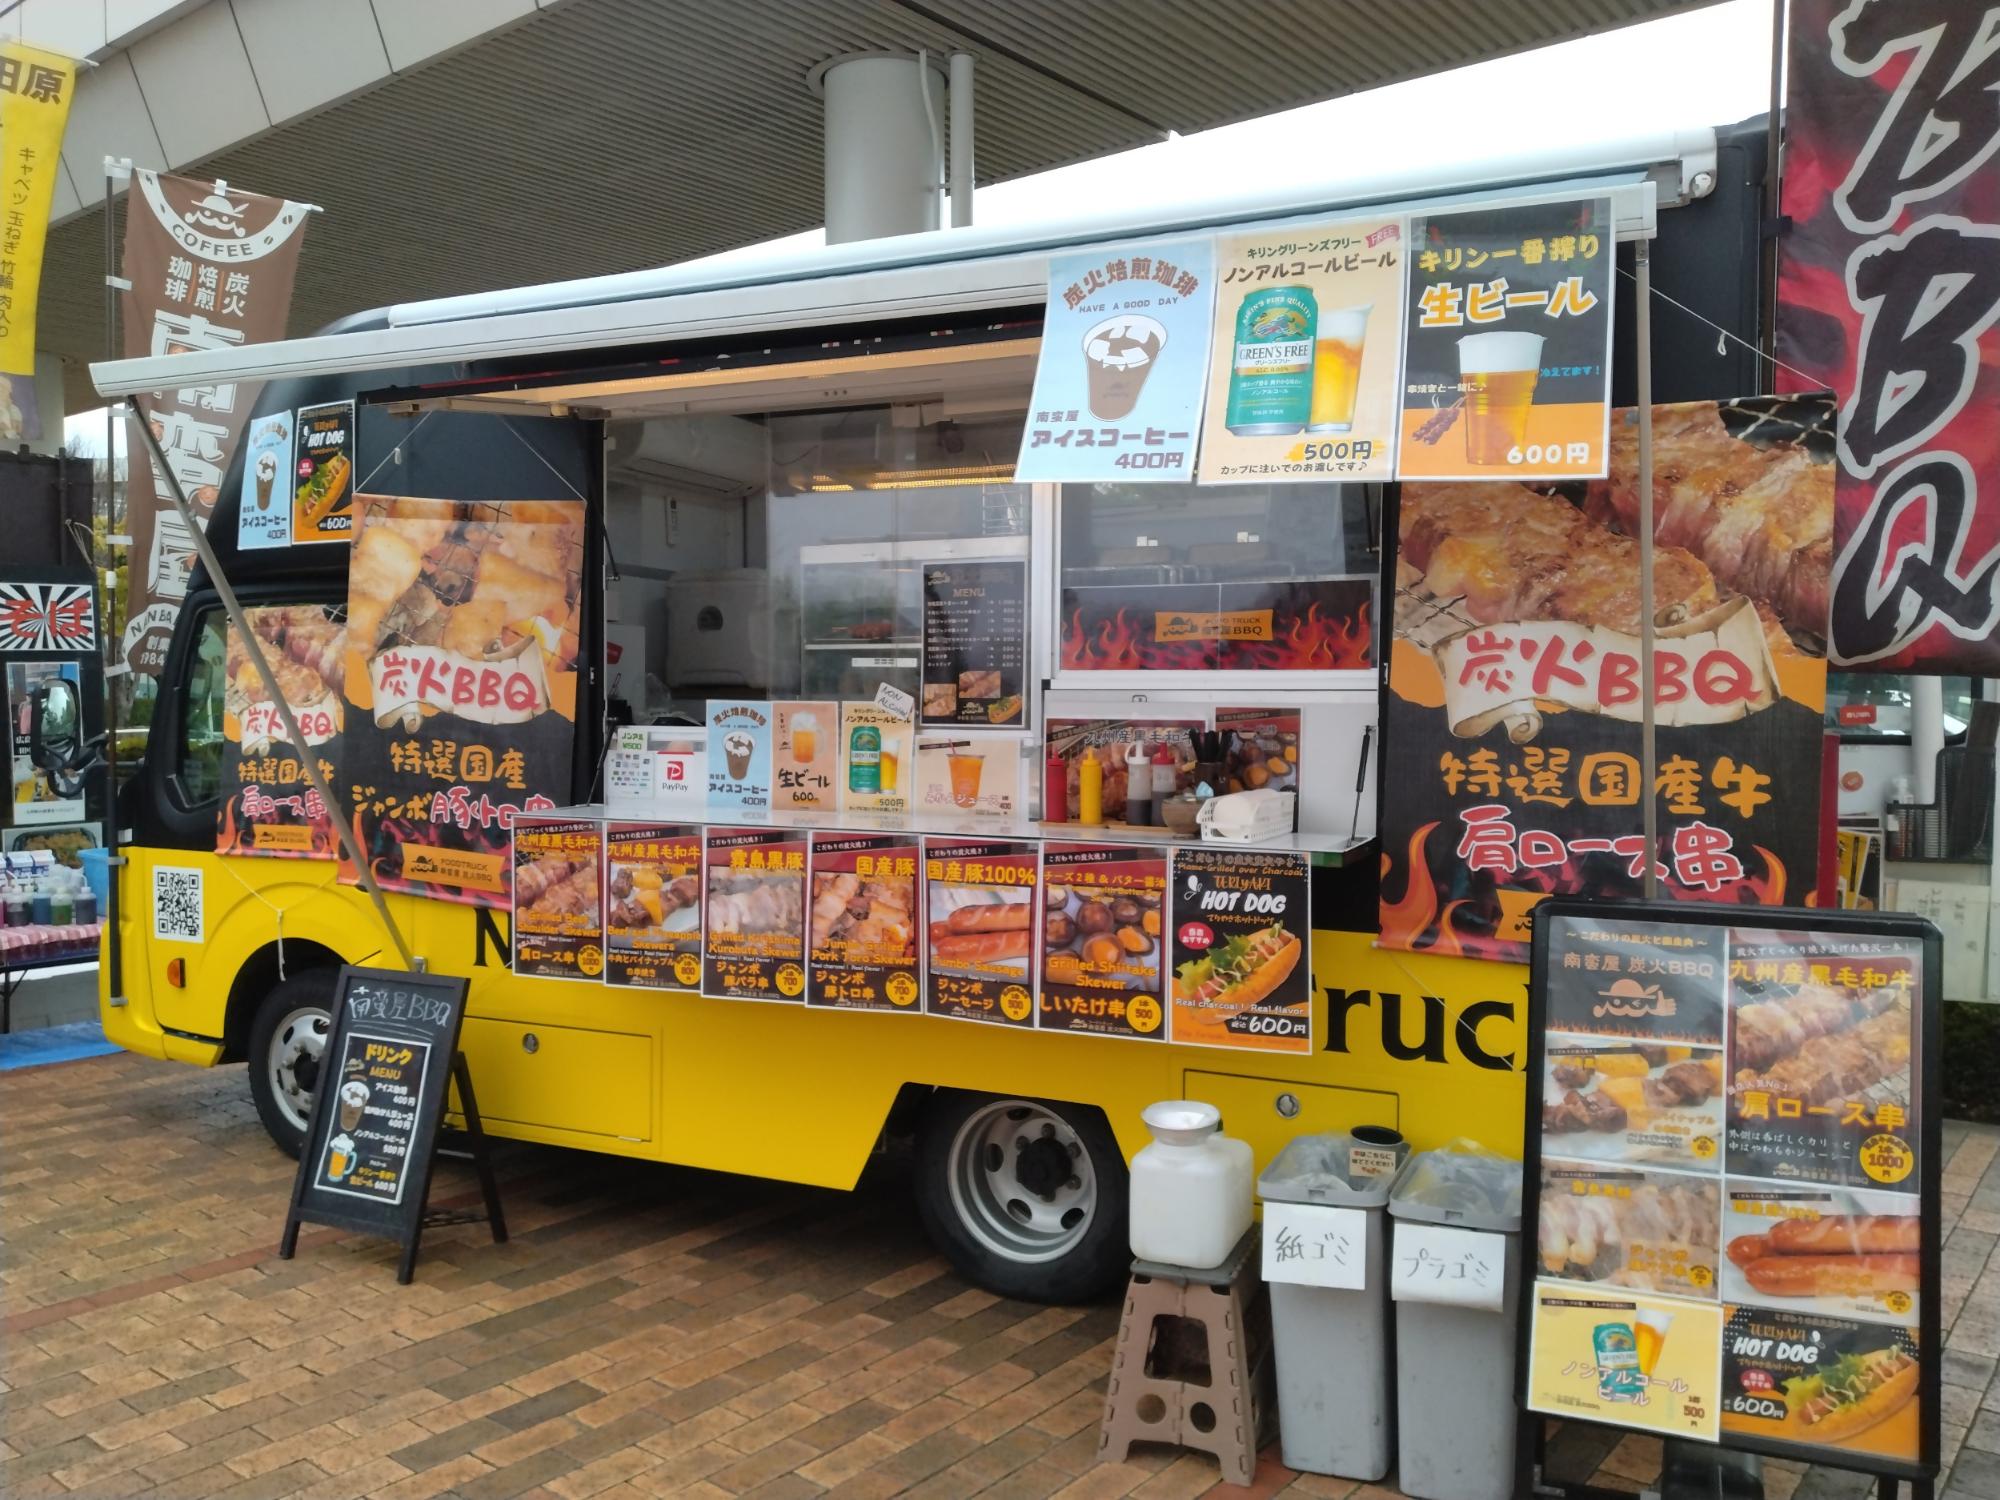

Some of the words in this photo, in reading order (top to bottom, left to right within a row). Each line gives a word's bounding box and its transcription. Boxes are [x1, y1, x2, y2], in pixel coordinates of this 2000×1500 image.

[172, 222, 254, 258] COFFEE
[1371, 226, 1395, 245] FREE
[1248, 239, 1361, 259] キリングリーンズフリー
[1418, 235, 1599, 273] キリン一番搾り
[1223, 252, 1396, 284] ノンアルコールビール
[164, 255, 193, 302] 珈琲
[193, 263, 219, 313] 焙煎
[1063, 257, 1199, 310] 炭火焙煎珈琲
[222, 271, 250, 318] 炭火
[1417, 276, 1599, 328] 生ビール
[1079, 303, 1106, 314] HAVE
[1112, 302, 1120, 310] A
[1123, 299, 1151, 309] GOOD
[1158, 297, 1178, 306] DAY
[1239, 346, 1282, 361] GREEN'S
[1284, 344, 1309, 357] FREE
[308, 433, 326, 447] HOT
[326, 430, 345, 444] DOG
[1031, 427, 1189, 448] アイスコーヒー
[1114, 452, 1184, 469] 400円
[1304, 441, 1372, 461] 500円
[1507, 443, 1590, 464] 600円
[953, 588, 986, 598] MENU
[0, 599, 91, 641] そば
[140, 652, 165, 666] 1984
[1459, 632, 1763, 706] 炭火BBQ
[380, 652, 541, 711] 炭火BBQ
[390, 740, 527, 790] 特選国産
[662, 782, 688, 792] PayPay
[778, 768, 831, 788] 生ビール
[1440, 747, 1772, 818] 特選国産牛
[709, 783, 768, 794] アイスコーヒー
[741, 797, 767, 806] 400円
[879, 798, 904, 807] 500円
[516, 833, 600, 849] 九州産黒毛和牛
[816, 841, 872, 851] こだわりの炭火焼き！
[1457, 805, 1745, 892] 肩ロース串
[607, 845, 702, 860] 九州産黒毛和牛
[730, 849, 804, 869] 霧島黒豚
[929, 848, 988, 857] こだわりの炭火焼き！
[1049, 853, 1113, 862] こだわりの炭火焼き！
[856, 856, 915, 876] 国産豚
[927, 860, 1036, 886] 国産豚100%
[1262, 867, 1304, 876] Charcoal
[1200, 890, 1242, 911] HOT
[1244, 892, 1287, 914] DOG
[520, 948, 575, 964] 肩ロース串
[812, 949, 838, 961] Pork
[873, 954, 917, 966] Skewer
[716, 961, 760, 974] ジャンボ
[816, 970, 865, 984] ジャンボ
[1048, 957, 1094, 971] Grilled
[1099, 961, 1157, 977] Shiitake
[1627, 955, 1714, 979] 炭火BBQ
[1729, 960, 1914, 991] 九州産黒毛和牛
[724, 975, 769, 989] 豚バラ串
[938, 978, 983, 994] ジャンボ
[1075, 975, 1127, 990] Skewer
[824, 985, 875, 1000] 豚トロ串
[938, 993, 994, 1010] ソーセージ
[1040, 992, 1126, 1018] しいたけ串
[1135, 1009, 1153, 1020] 500
[1175, 998, 1196, 1007] Real
[1250, 1003, 1272, 1013] Real
[1249, 1016, 1307, 1034] 600円
[1311, 974, 1528, 1072] ruc
[365, 1043, 413, 1065] ドリンク
[369, 1065, 402, 1080] MENU
[1740, 1090, 1906, 1133] 肩ロース串
[1868, 1155, 1904, 1169] 1000
[1275, 1226, 1350, 1266] 紙ゴミ
[1403, 1248, 1490, 1288] プラゴミ
[1732, 1336, 1774, 1357] HOT
[1776, 1341, 1819, 1364] DOG
[1561, 1361, 1688, 1393] ノンアルコール
[1598, 1385, 1649, 1406] ビール
[1683, 1404, 1705, 1419] 500
[1733, 1397, 1784, 1418] 600円
